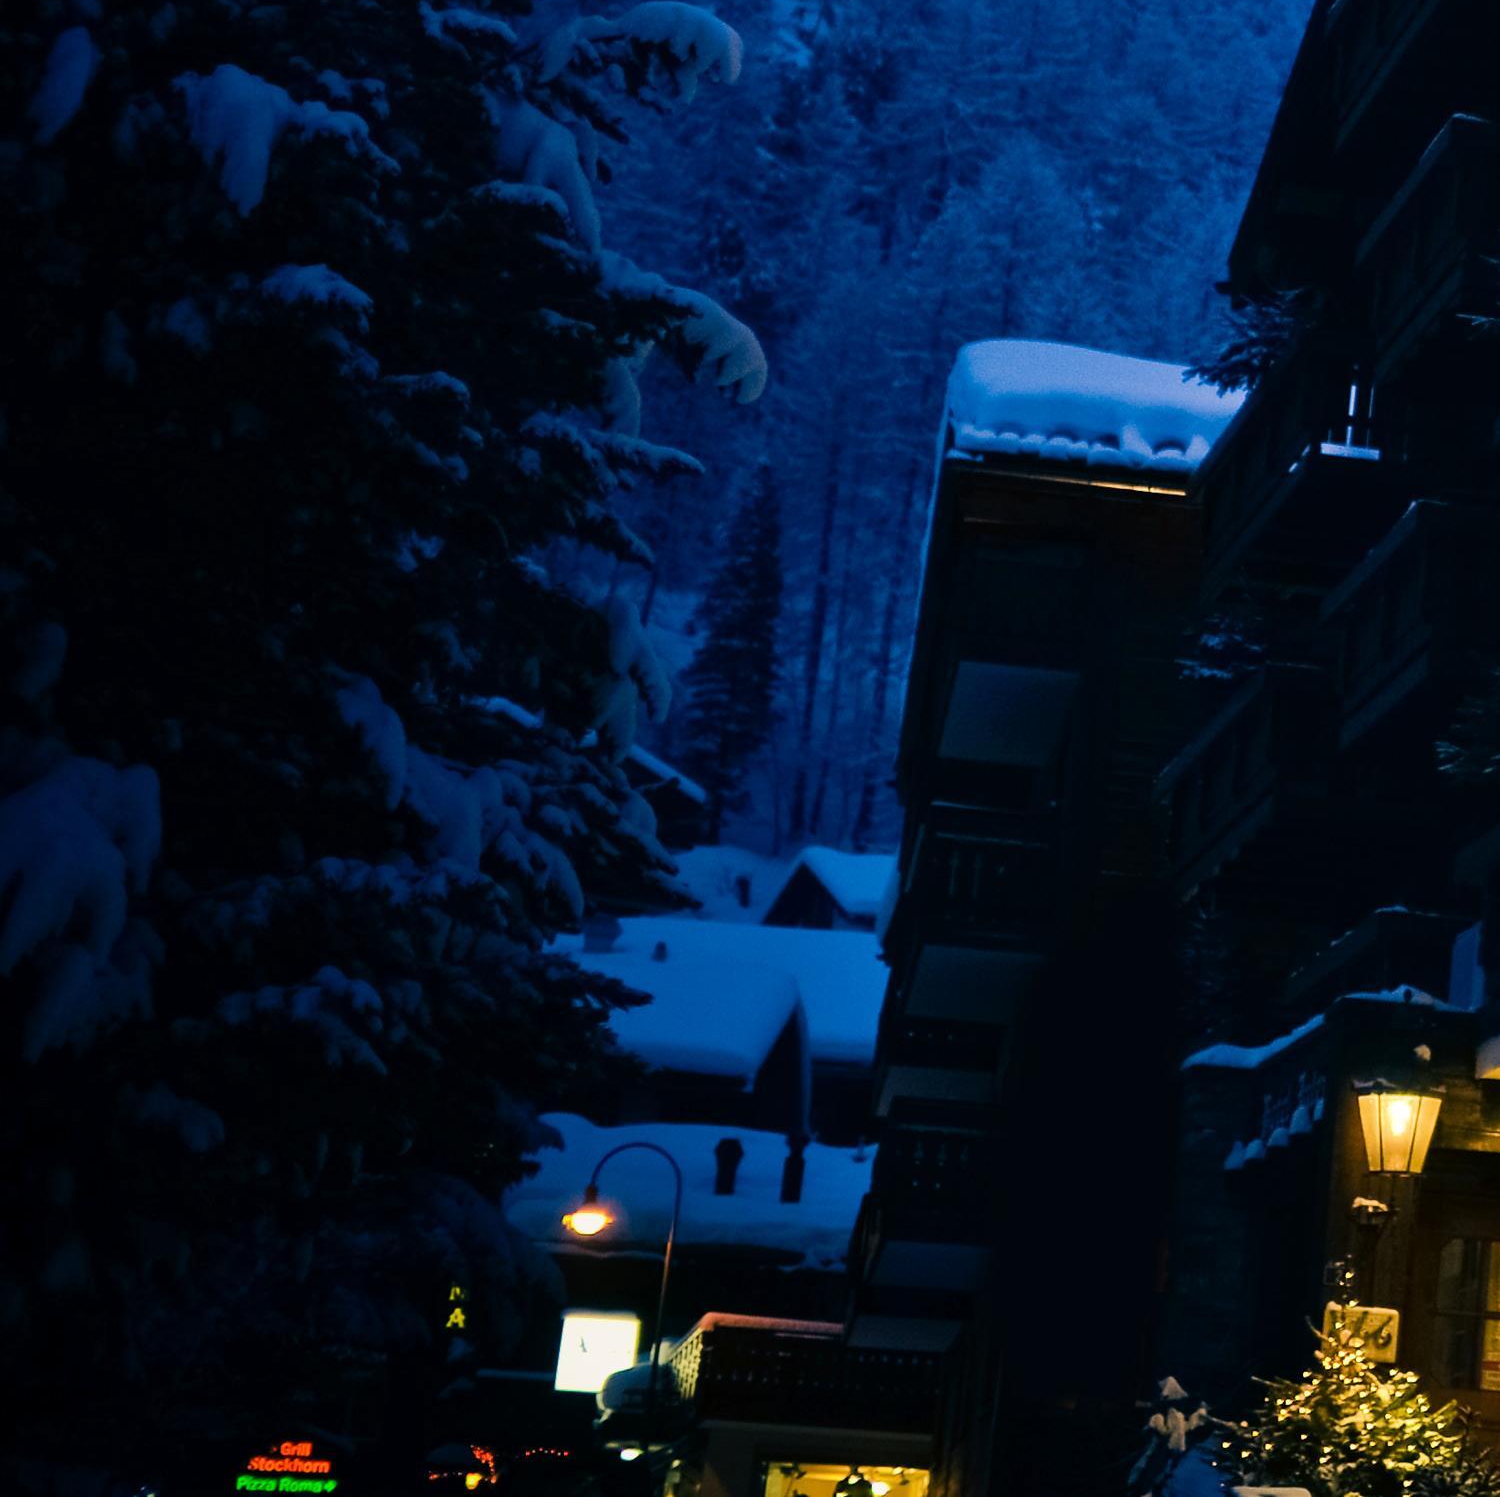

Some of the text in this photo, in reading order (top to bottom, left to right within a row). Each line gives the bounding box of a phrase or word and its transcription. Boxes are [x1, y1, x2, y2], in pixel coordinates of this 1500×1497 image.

[280, 1441, 314, 1457] Grill
[248, 1456, 332, 1474] Stockhorn
[236, 1475, 323, 1494] Pizza Roma
